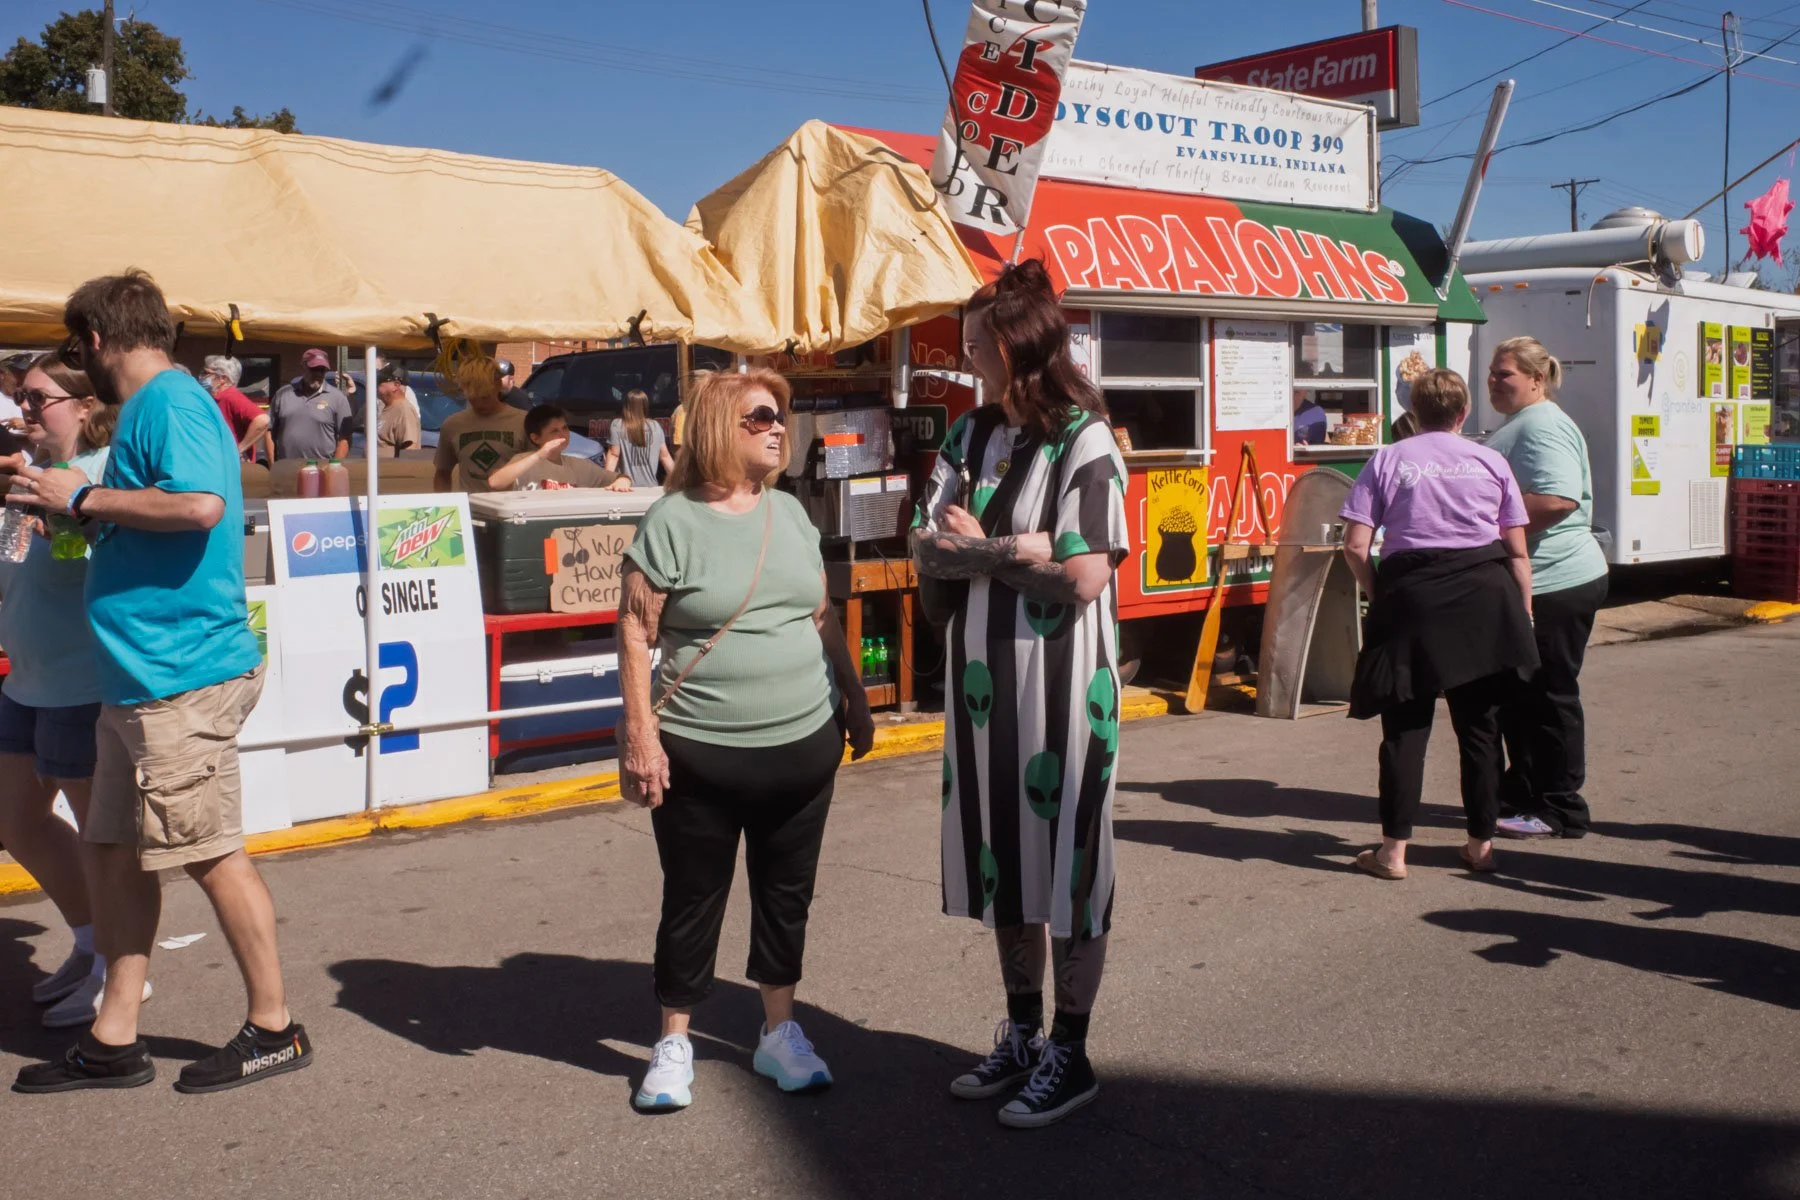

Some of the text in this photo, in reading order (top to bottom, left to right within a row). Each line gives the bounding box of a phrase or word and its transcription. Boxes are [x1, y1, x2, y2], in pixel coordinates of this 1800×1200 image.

[1114, 77, 1156, 104] Loyal
[1161, 84, 1208, 110] Helpful
[1214, 95, 1268, 121] Friendly
[1272, 103, 1322, 123] Courteous
[1325, 111, 1350, 126] Kind
[1054, 100, 1344, 155] OYSCOUT TROOP 399
[1047, 150, 1351, 193] dient Cheerful Thrifty Brave Clean Reverent
[1176, 146, 1346, 174] EVANSVILLE, INDIANA
[1151, 468, 1205, 495] Kettle Corn
[320, 533, 368, 552] peps
[592, 534, 625, 556] We
[572, 564, 622, 584] Have
[381, 578, 439, 615] SINGLE
[561, 585, 621, 605] Cherr
[242, 1045, 294, 1077] NASCAR
